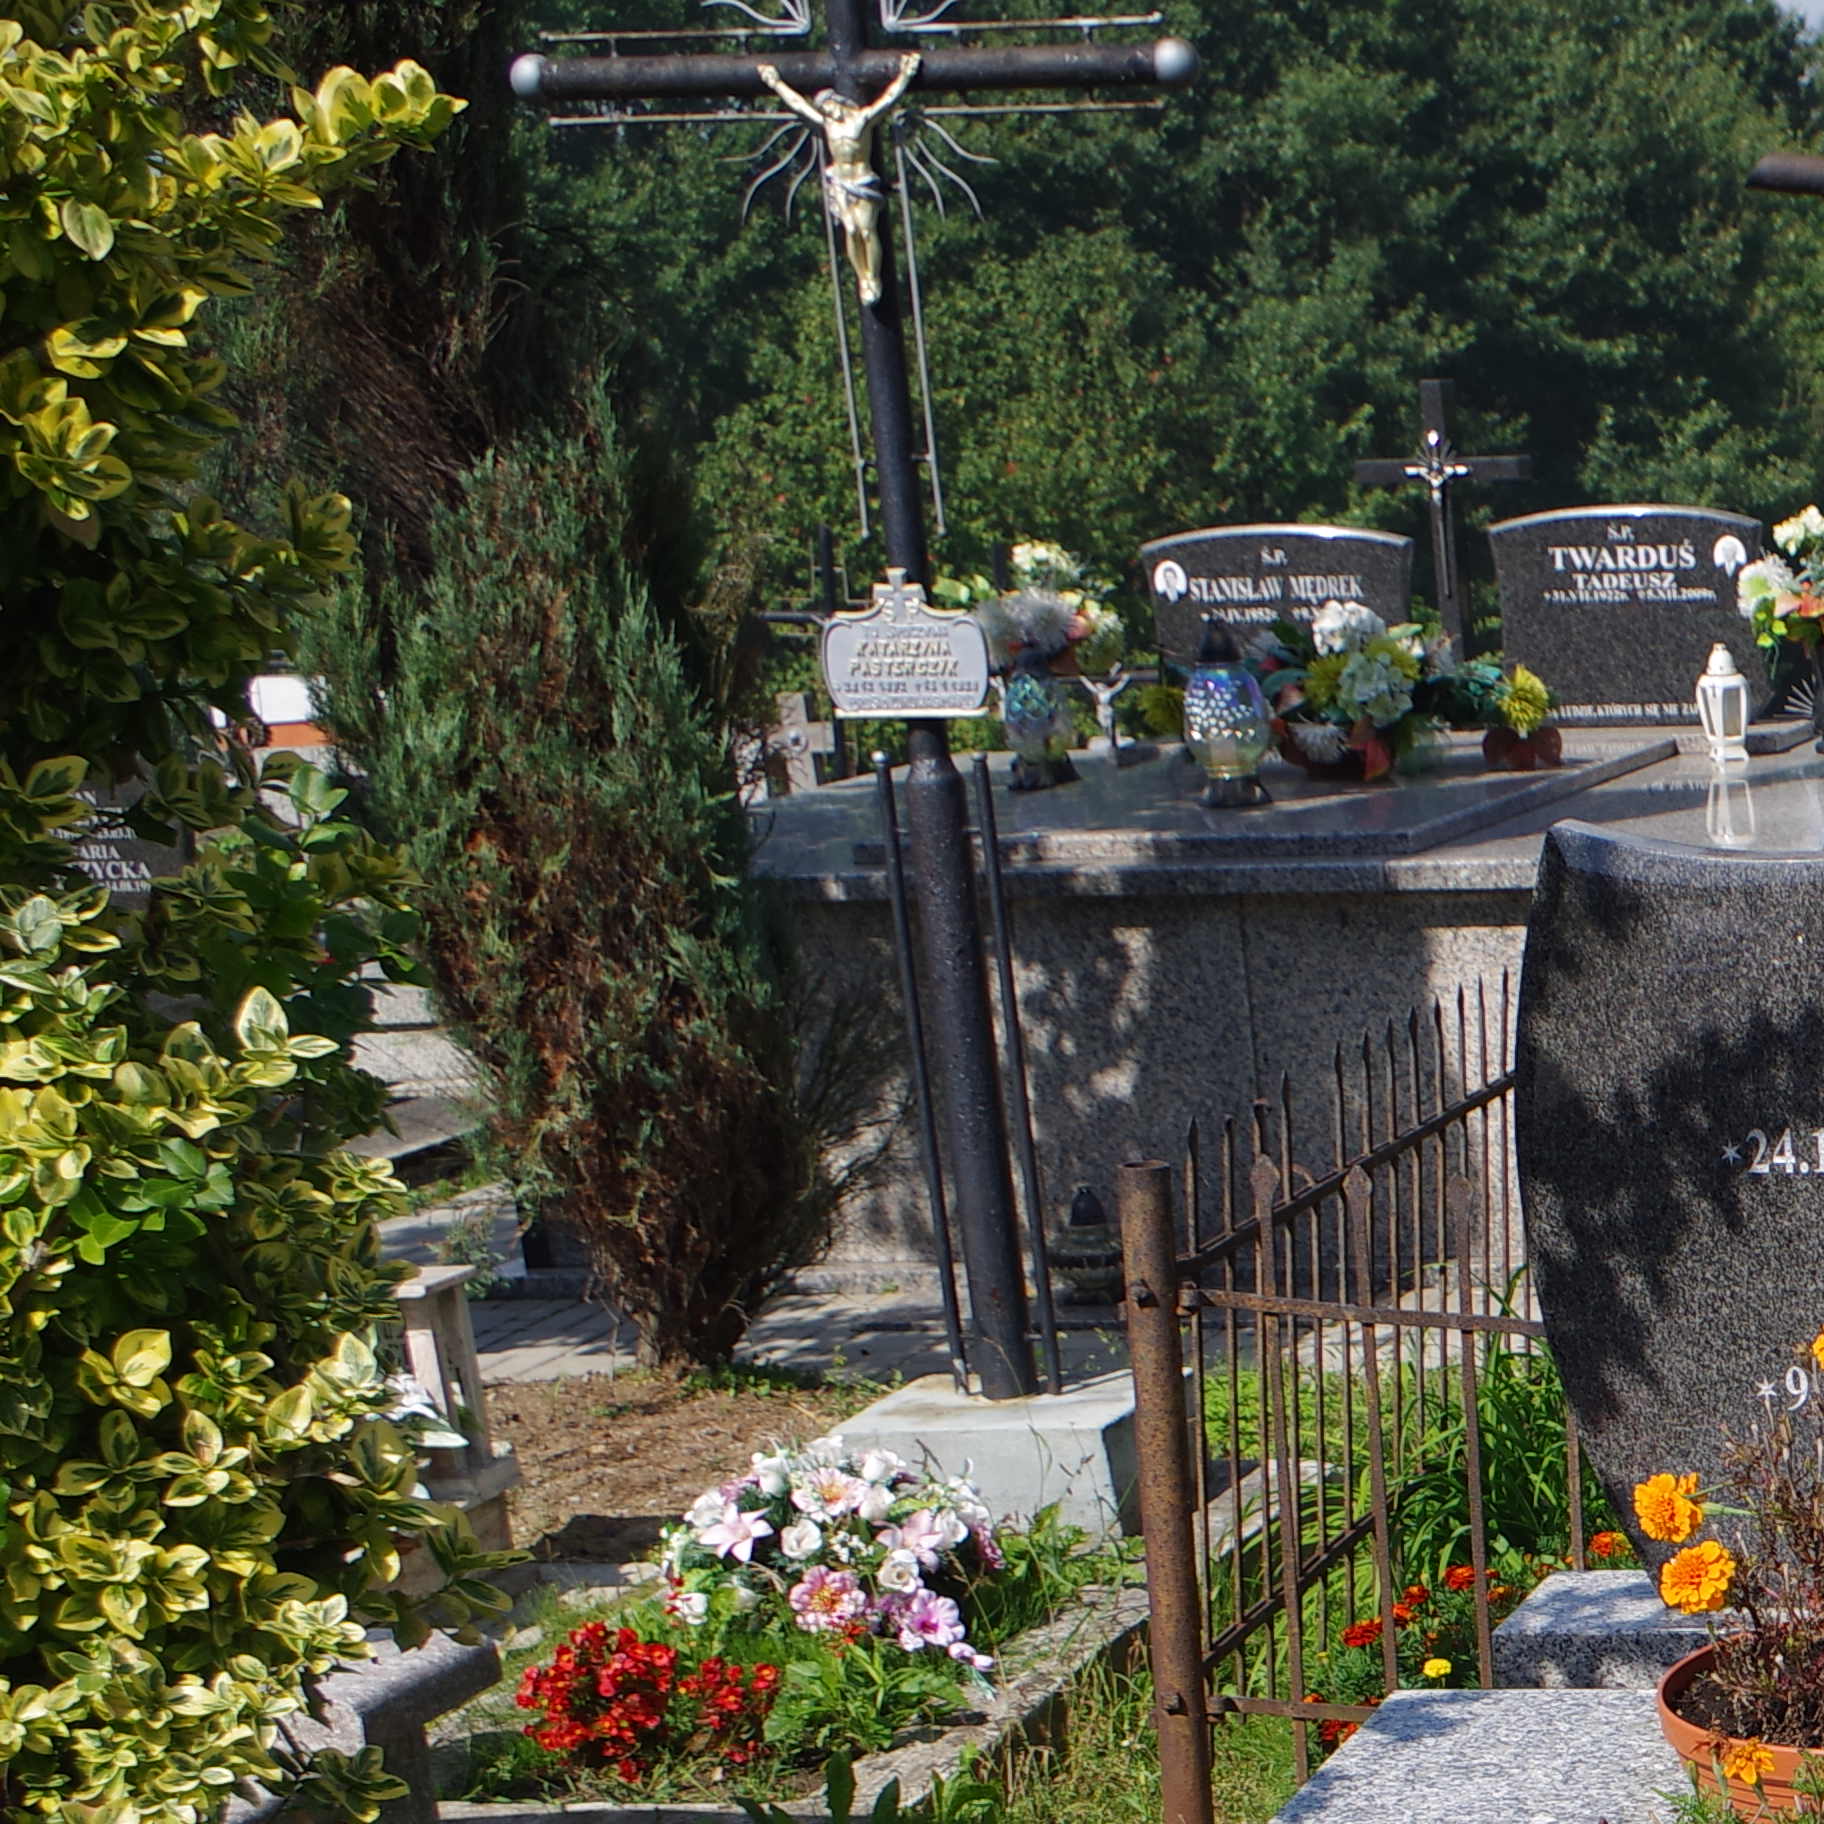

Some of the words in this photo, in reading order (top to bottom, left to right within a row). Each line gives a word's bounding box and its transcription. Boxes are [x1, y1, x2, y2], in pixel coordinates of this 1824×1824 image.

[1547, 539, 1697, 571] TWARDUŚ
[1288, 574, 1365, 604] MĘDREK
[1571, 571, 1677, 590] TADEUSZ
